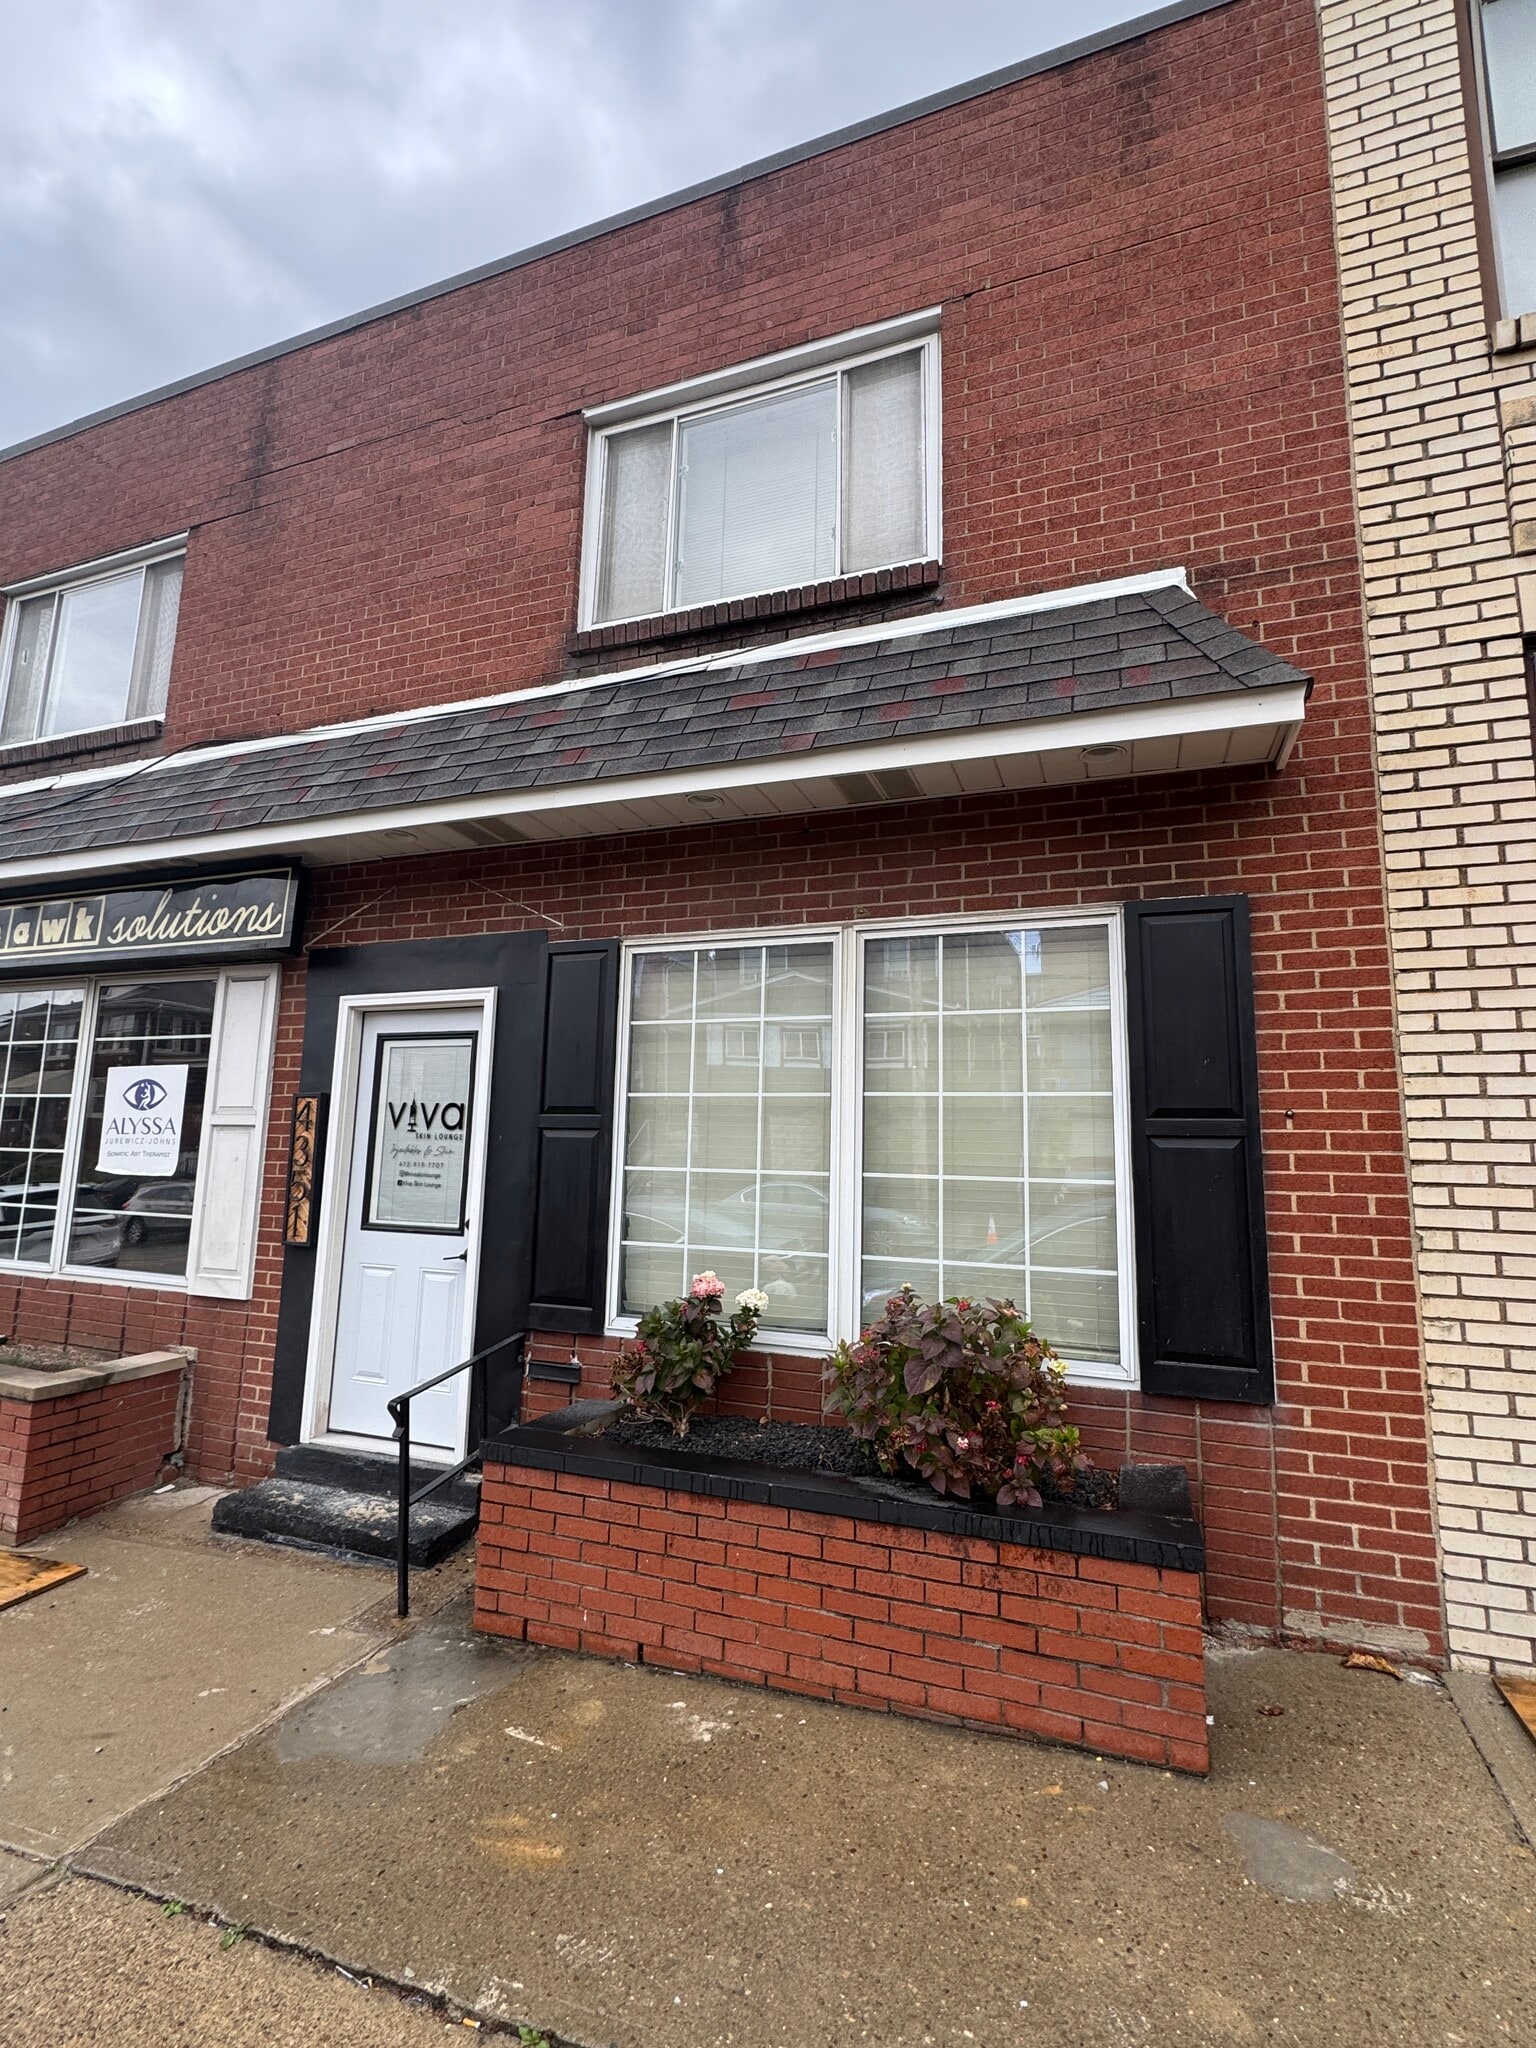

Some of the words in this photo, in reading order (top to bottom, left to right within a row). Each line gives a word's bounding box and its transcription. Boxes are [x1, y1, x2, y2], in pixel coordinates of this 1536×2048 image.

[0, 907, 95, 945] awk
[107, 888, 282, 945] solutions
[106, 1117, 176, 1136] ALYSSA
[105, 1137, 176, 1145] JUREWICZ-JOHNS
[415, 1132, 431, 1140] SKIN
[434, 1133, 464, 1141] LOUNGE
[289, 1101, 313, 1238] 4351
